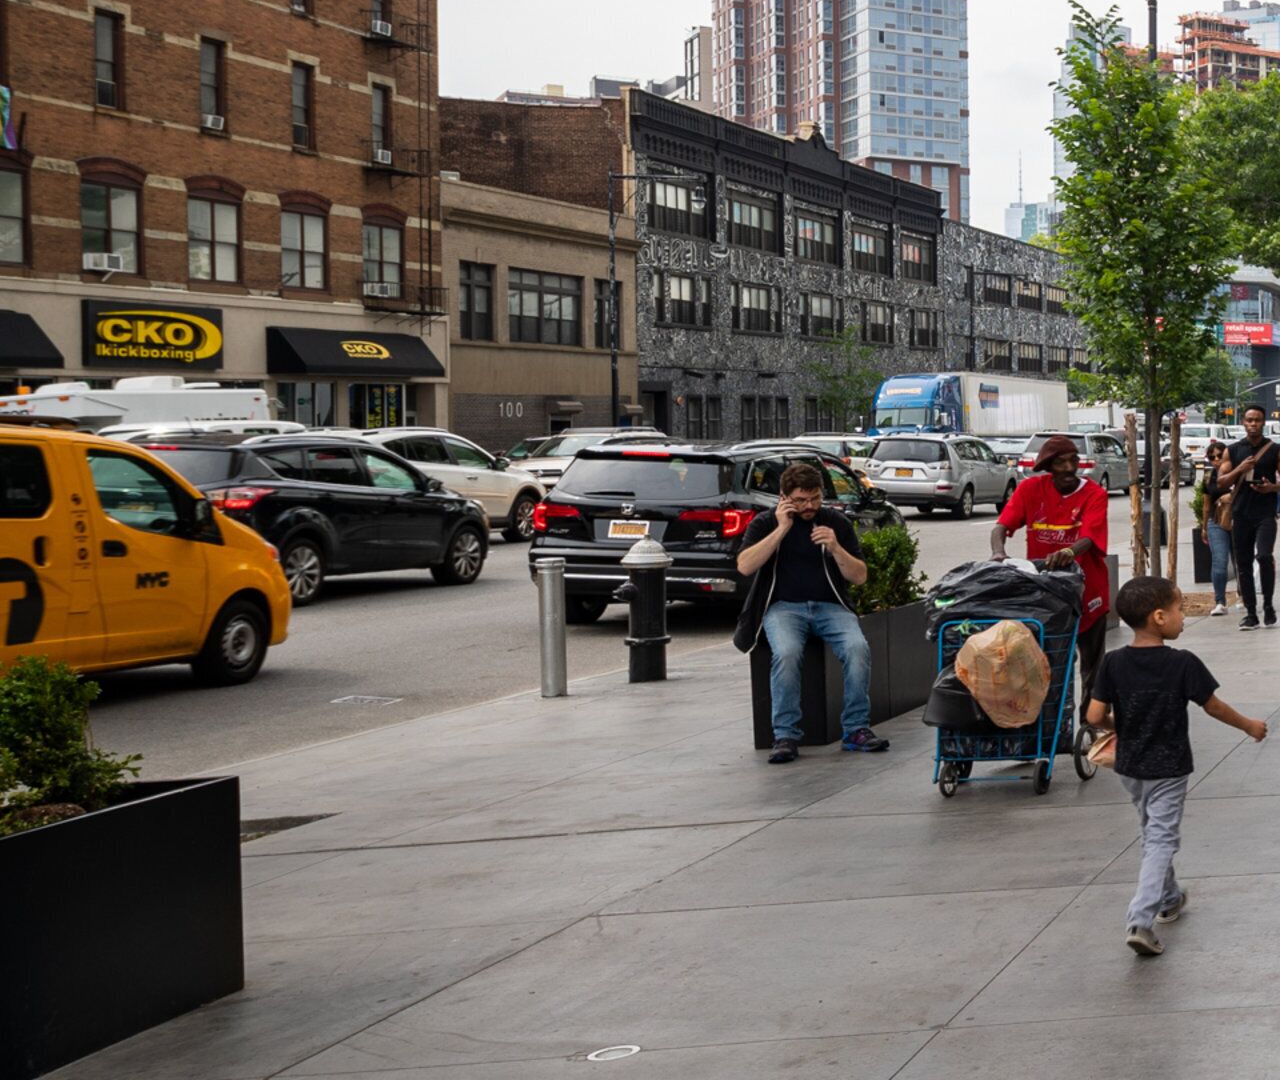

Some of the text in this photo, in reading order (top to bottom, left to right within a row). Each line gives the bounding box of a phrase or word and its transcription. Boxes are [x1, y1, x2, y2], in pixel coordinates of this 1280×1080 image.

[100, 318, 194, 346] CKO
[1225, 324, 1265, 333] retail space
[97, 344, 195, 362] kickboxing
[342, 343, 378, 354] CKO
[499, 401, 524, 418] 100
[135, 571, 170, 590] NYC
